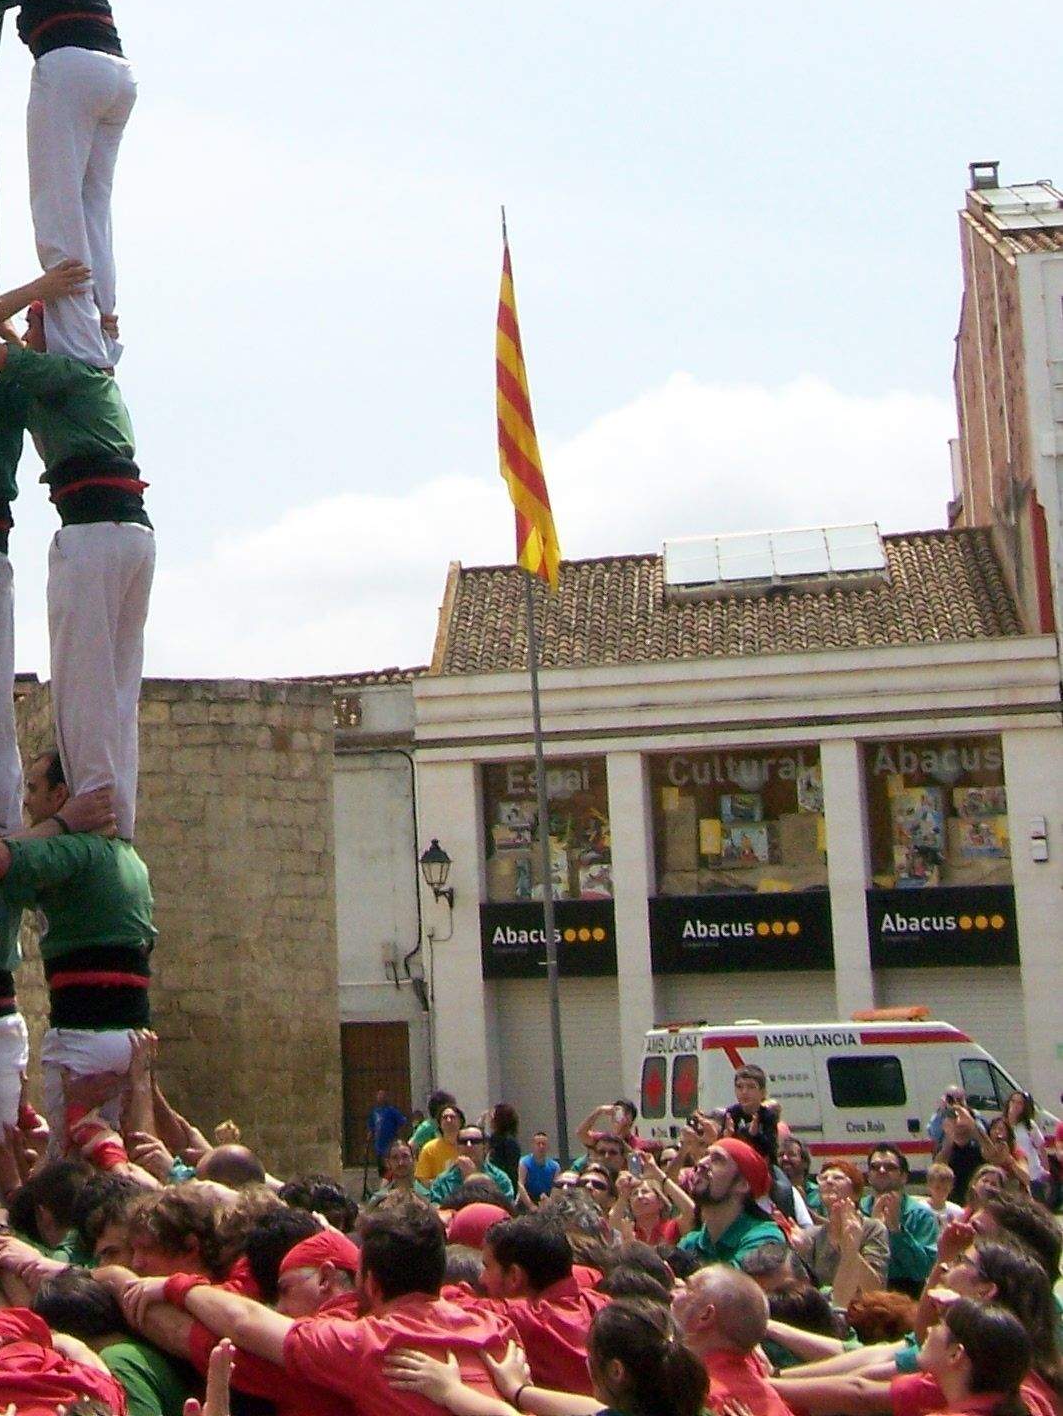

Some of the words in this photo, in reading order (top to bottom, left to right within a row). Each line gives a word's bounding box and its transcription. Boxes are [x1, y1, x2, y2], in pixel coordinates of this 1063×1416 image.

[874, 742, 1003, 774] Abacus
[682, 920, 755, 938] Abacus
[881, 912, 956, 932] Abacus
[763, 1033, 857, 1048] AMBULANCIA
